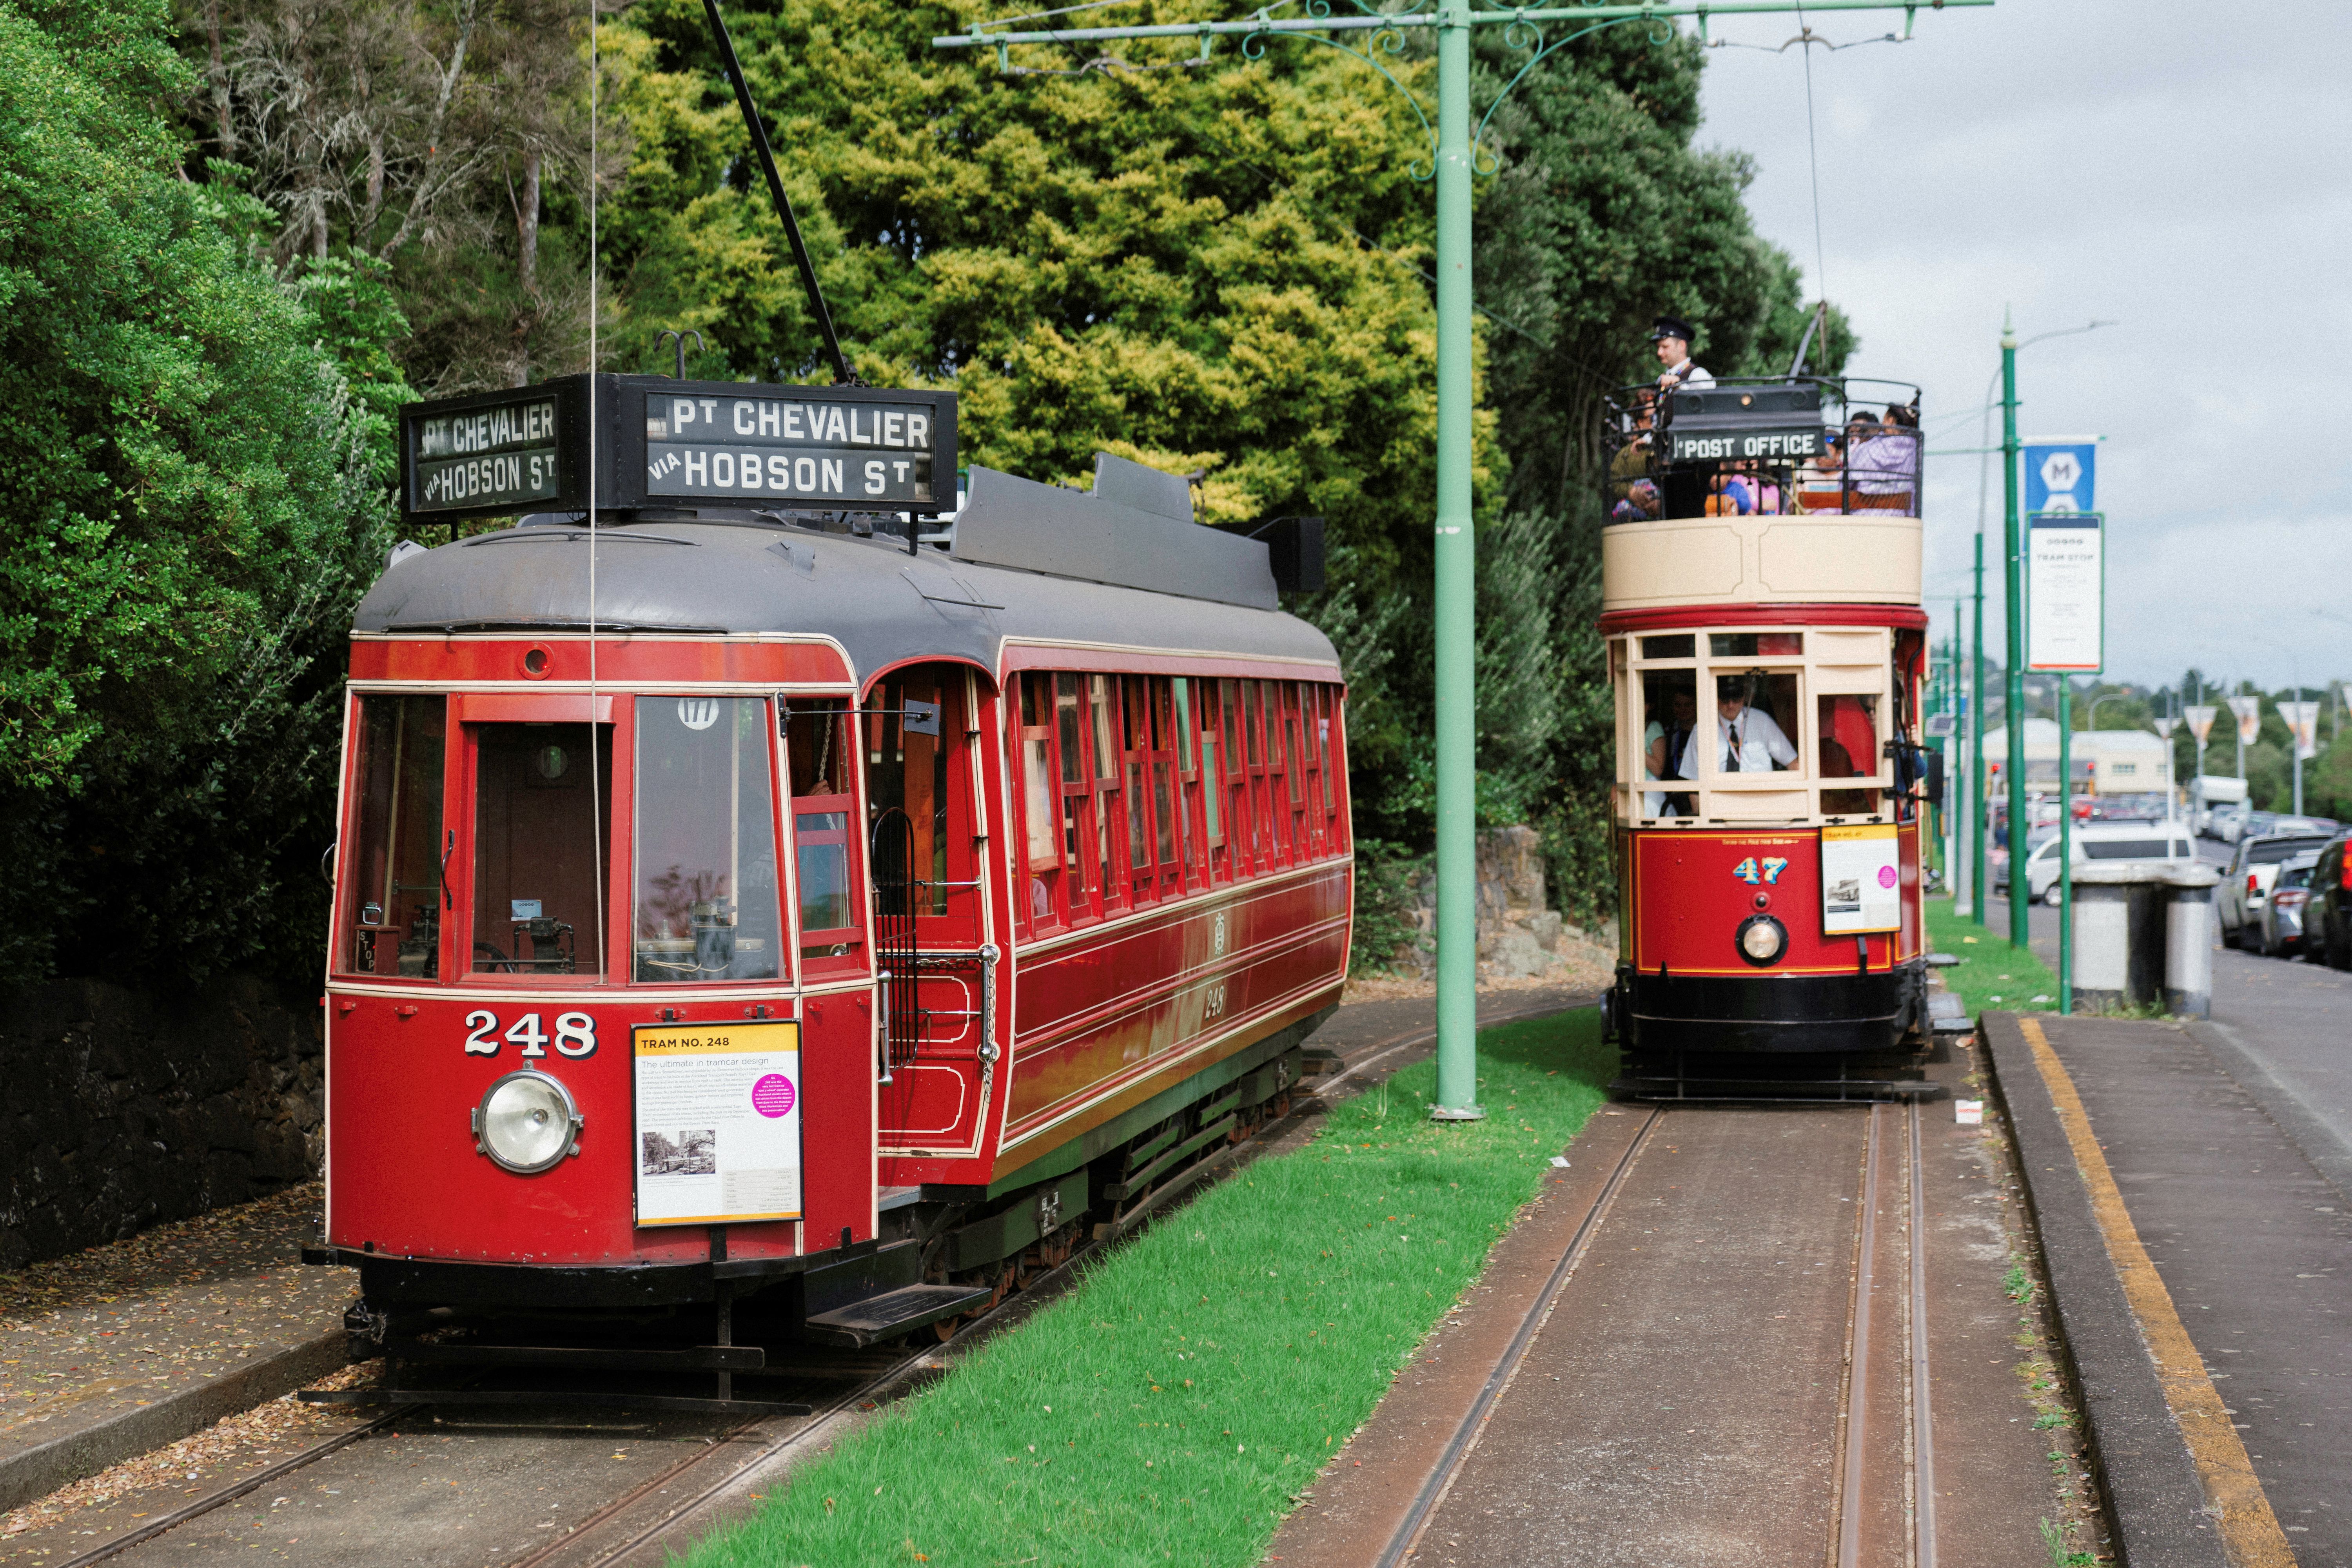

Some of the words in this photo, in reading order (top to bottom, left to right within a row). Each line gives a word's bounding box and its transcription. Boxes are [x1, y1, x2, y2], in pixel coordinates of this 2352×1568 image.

[453, 403, 554, 452] CHEVALIER
[674, 399, 717, 434] PT
[733, 401, 927, 448] CHEVALIER
[1744, 434, 1815, 457] OFFICE
[425, 473, 441, 501] VIA
[441, 456, 520, 502] HOBSON
[530, 454, 555, 490] ST
[648, 452, 681, 480] VIA
[685, 450, 843, 493] HOBSON
[865, 461, 910, 494] ST
[2052, 463, 2070, 481] M
[1733, 857, 1788, 884] 47
[359, 931, 375, 969] STOP
[1205, 984, 1224, 1020] 248
[465, 1010, 599, 1061] 248
[641, 1039, 677, 1049] TRAM
[681, 1038, 702, 1047] NO.
[707, 1037, 730, 1047] 248
[660, 1060, 693, 1068] ultimate
[741, 1057, 769, 1066] design
